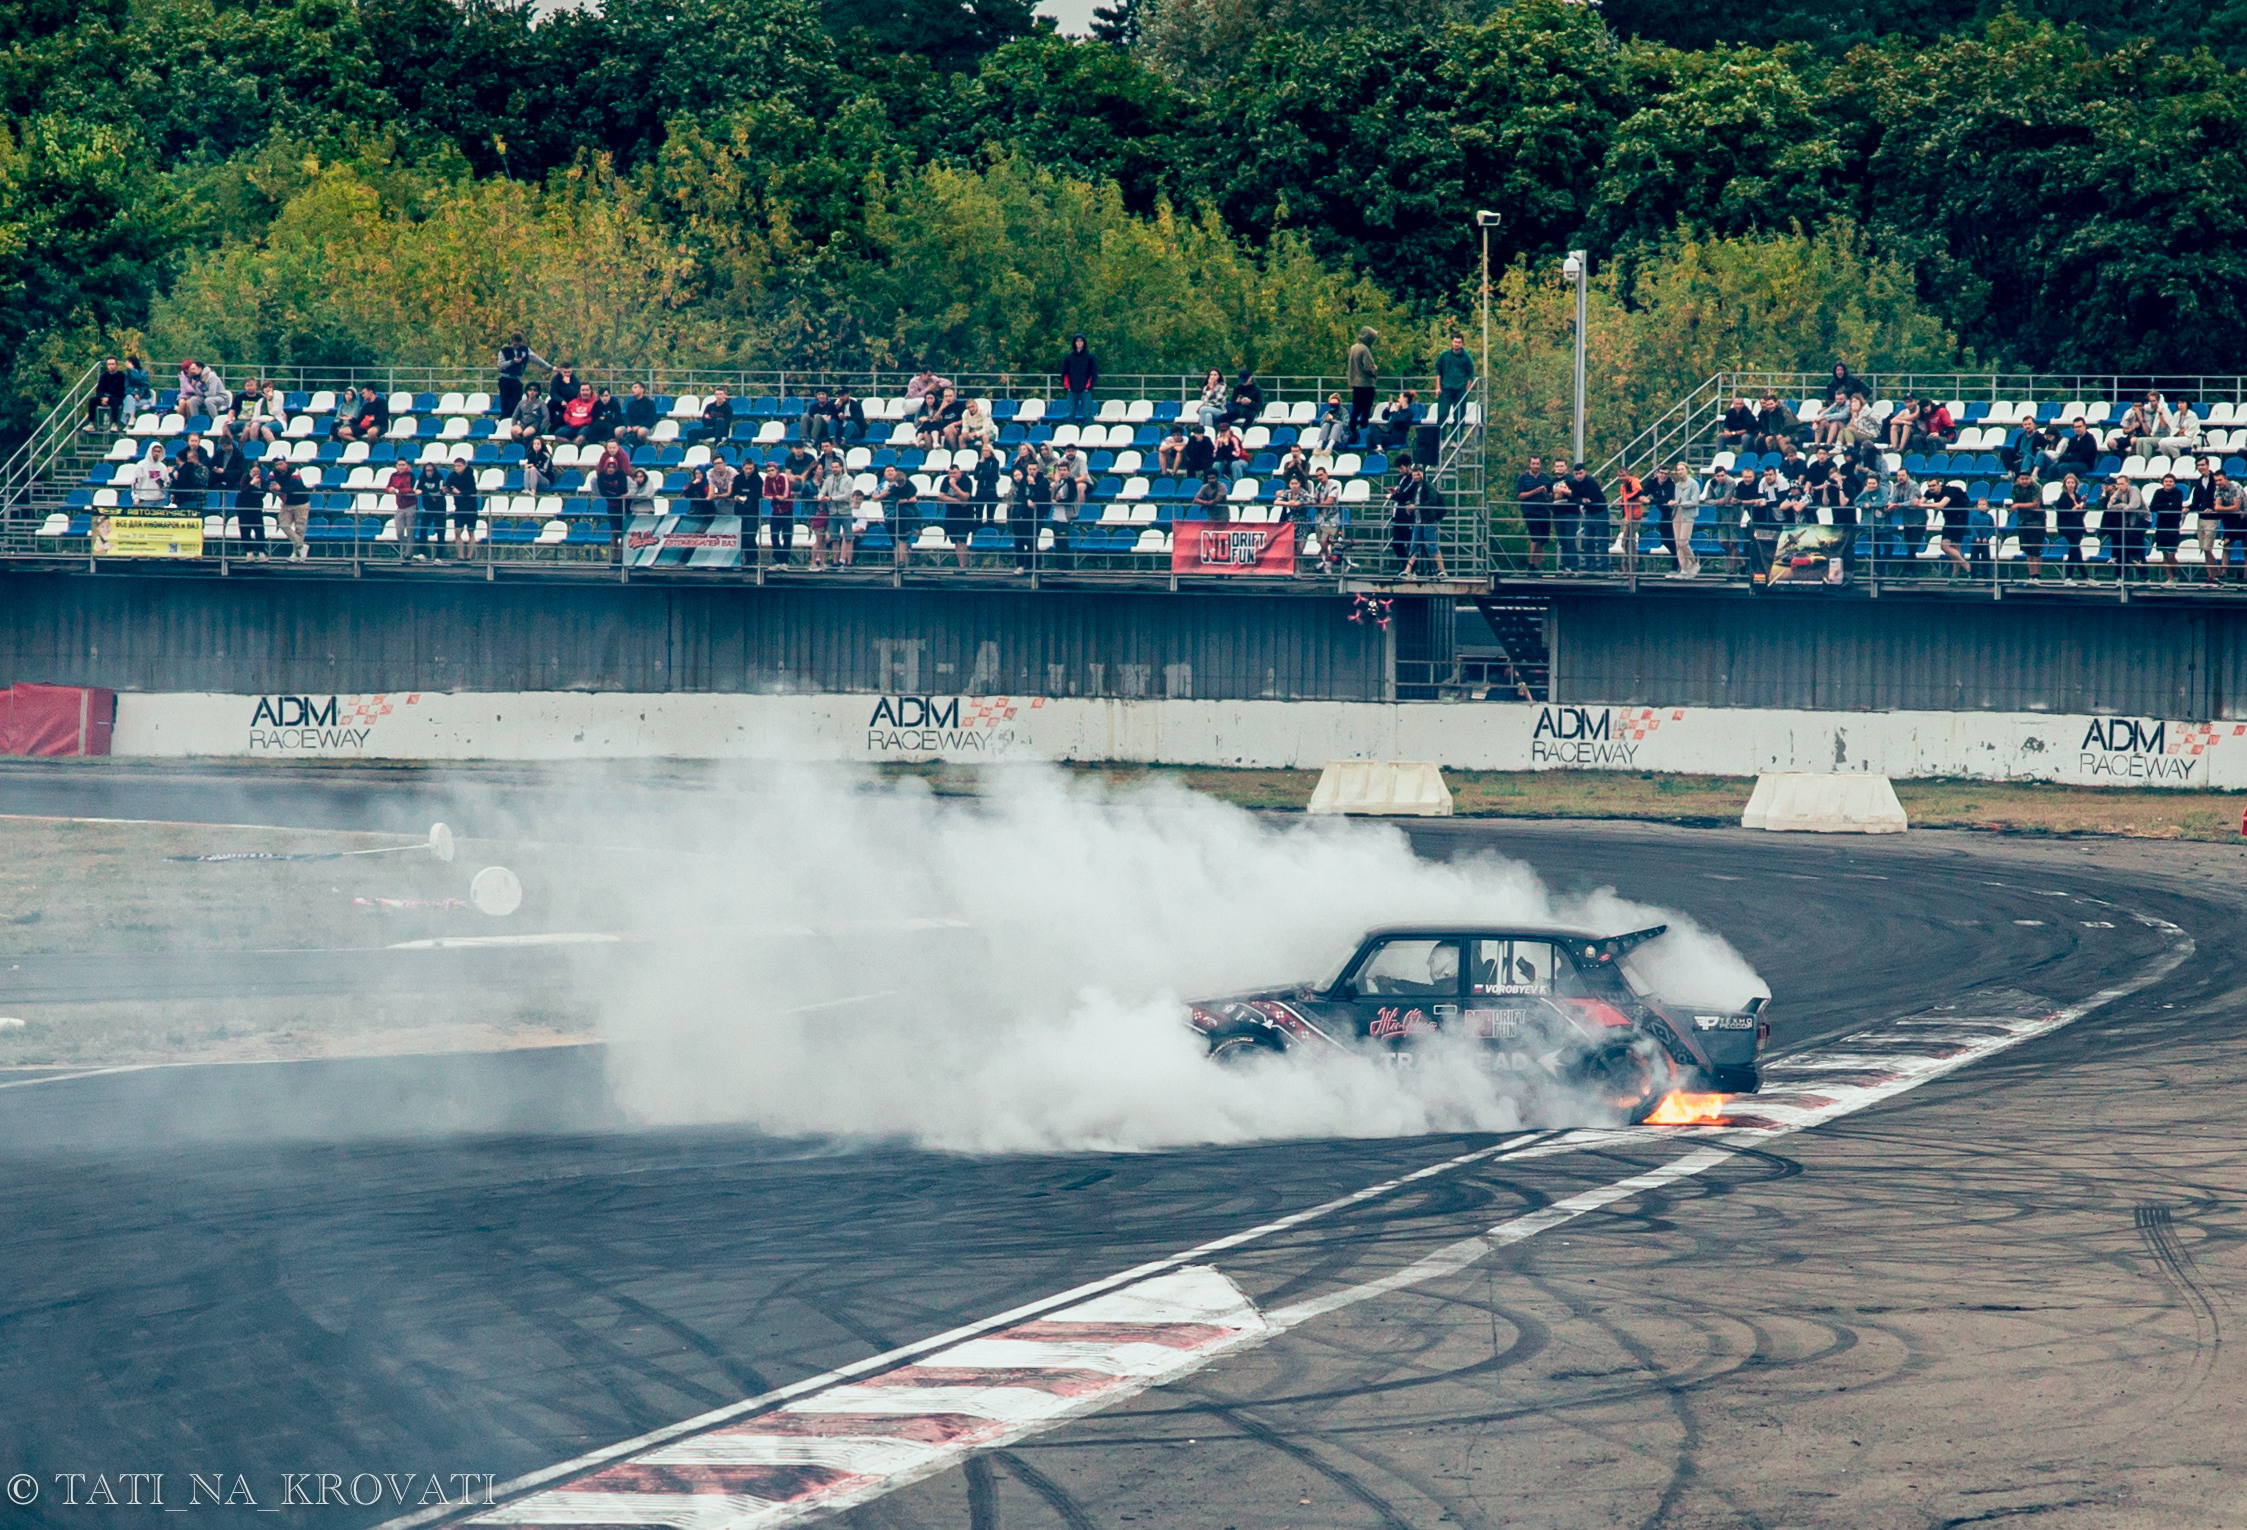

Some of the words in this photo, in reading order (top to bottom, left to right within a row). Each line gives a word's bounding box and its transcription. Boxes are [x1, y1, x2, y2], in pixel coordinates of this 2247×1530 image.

[1202, 530, 1232, 563] NO
[1231, 531, 1266, 548] DRIFT
[1231, 547, 1256, 563] FUN
[250, 696, 337, 727] ADM
[869, 697, 959, 728] ADM
[1533, 707, 1610, 741] ADM
[250, 728, 370, 749] RACEWAY
[868, 730, 993, 750] RACEWAY
[2081, 718, 2165, 754] ADM
[1532, 741, 1639, 763] RACEWAY
[2080, 752, 2197, 780] RACEWAY
[1485, 984, 1538, 995] VOROBYEV
[1493, 1010, 1525, 1023] DRIFT
